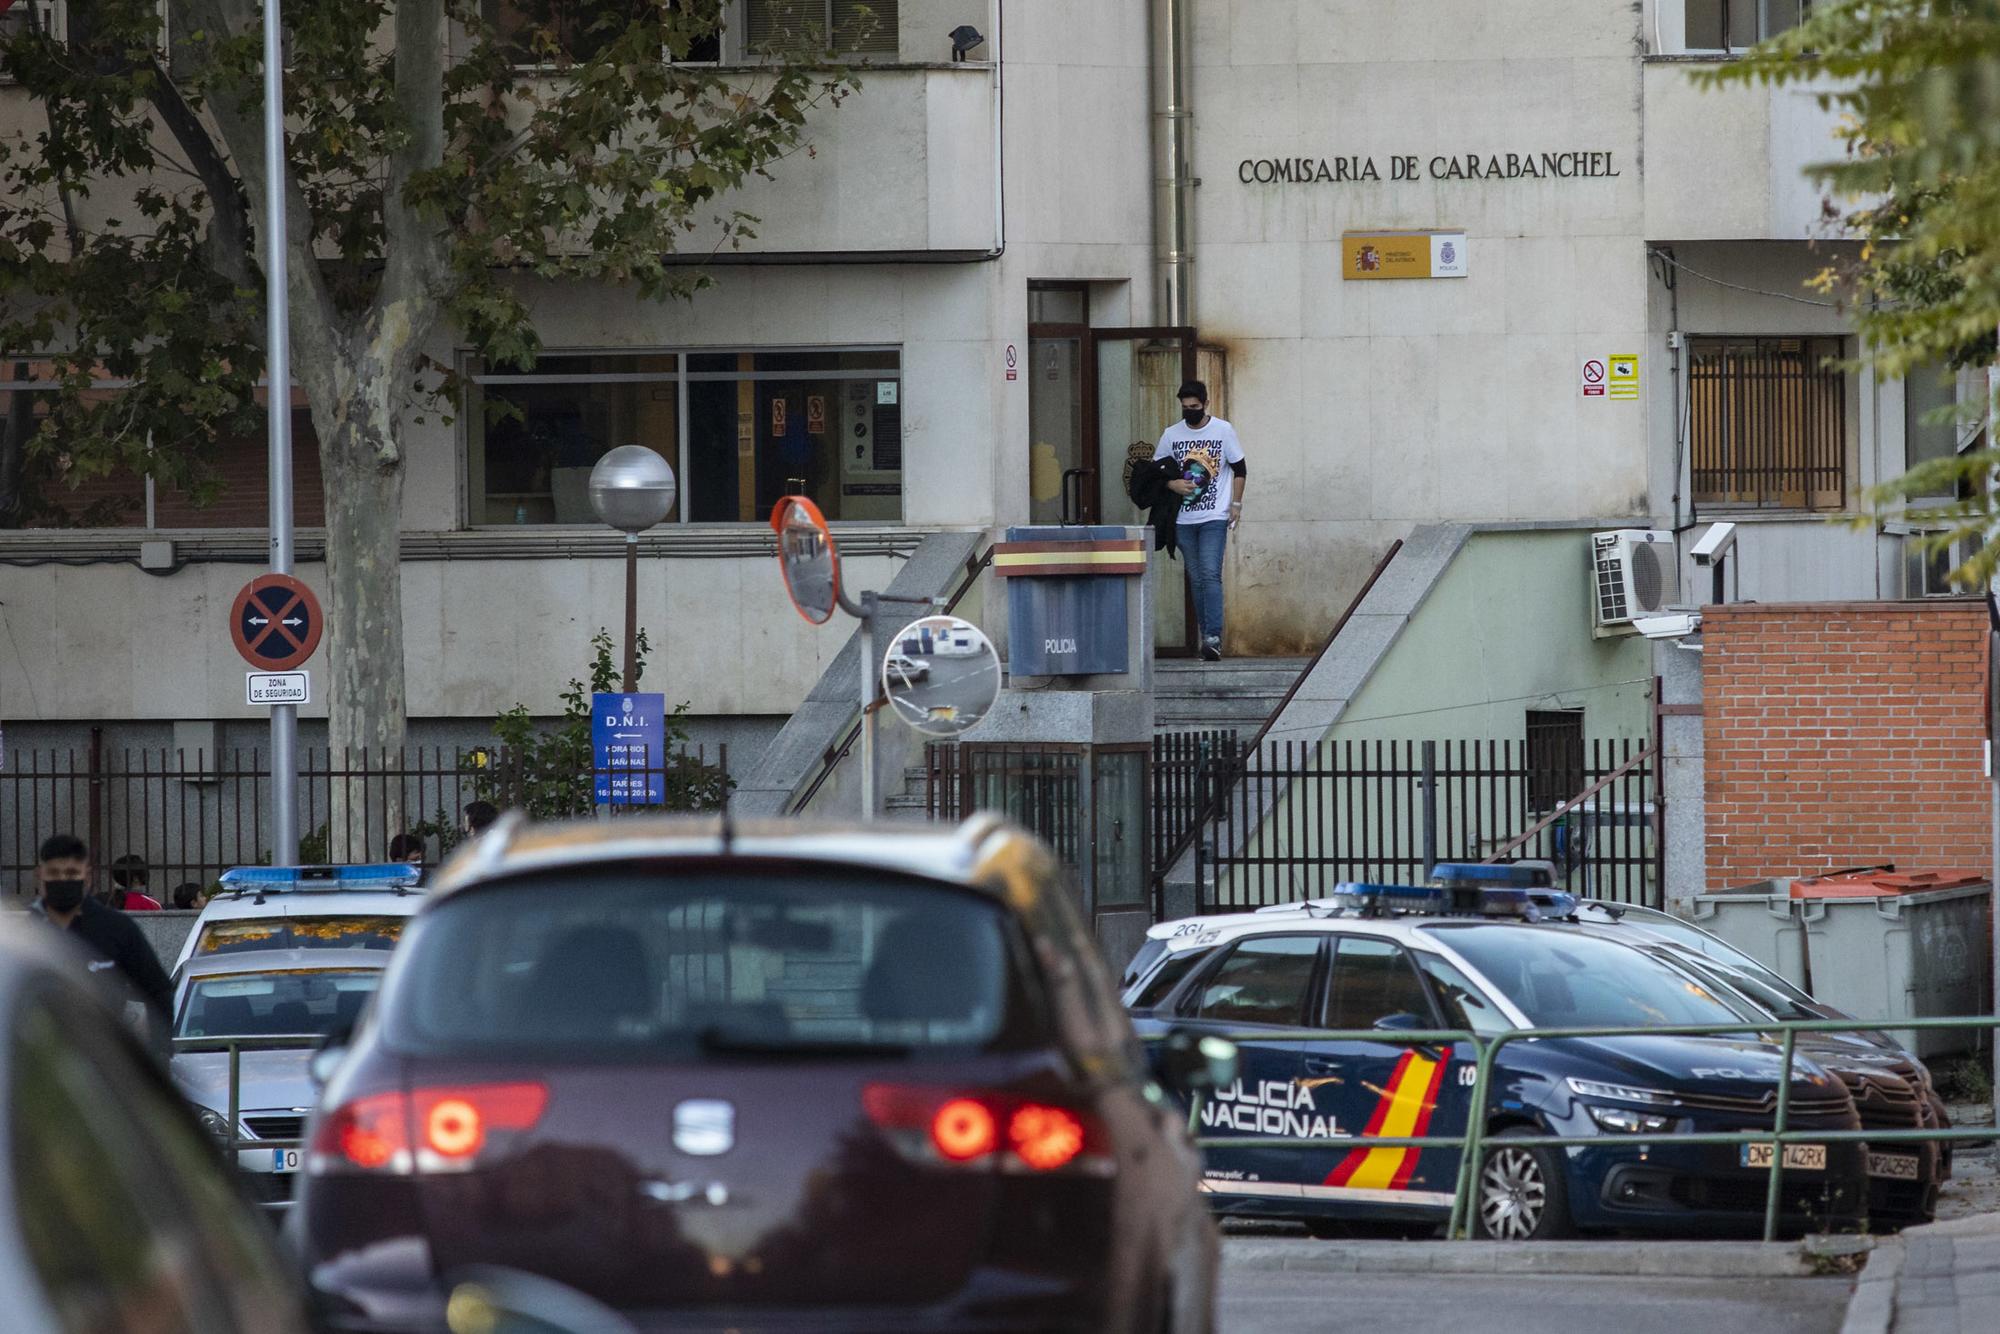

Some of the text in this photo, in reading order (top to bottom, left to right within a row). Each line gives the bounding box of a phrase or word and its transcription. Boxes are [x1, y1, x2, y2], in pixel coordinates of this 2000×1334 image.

[1238, 151, 1620, 184] COMISARIA DE CARABANCHEL
[1172, 440, 1222, 450] NOTORIOUS
[268, 678, 287, 687] ZONA
[254, 687, 302, 698] DE SEGURIDAD
[606, 715, 649, 727] D.N.I.
[1214, 1077, 1316, 1112] OLICÍA
[1200, 1101, 1352, 1139] NACIONAL
[1748, 1145, 1826, 1167] CNP142RX
